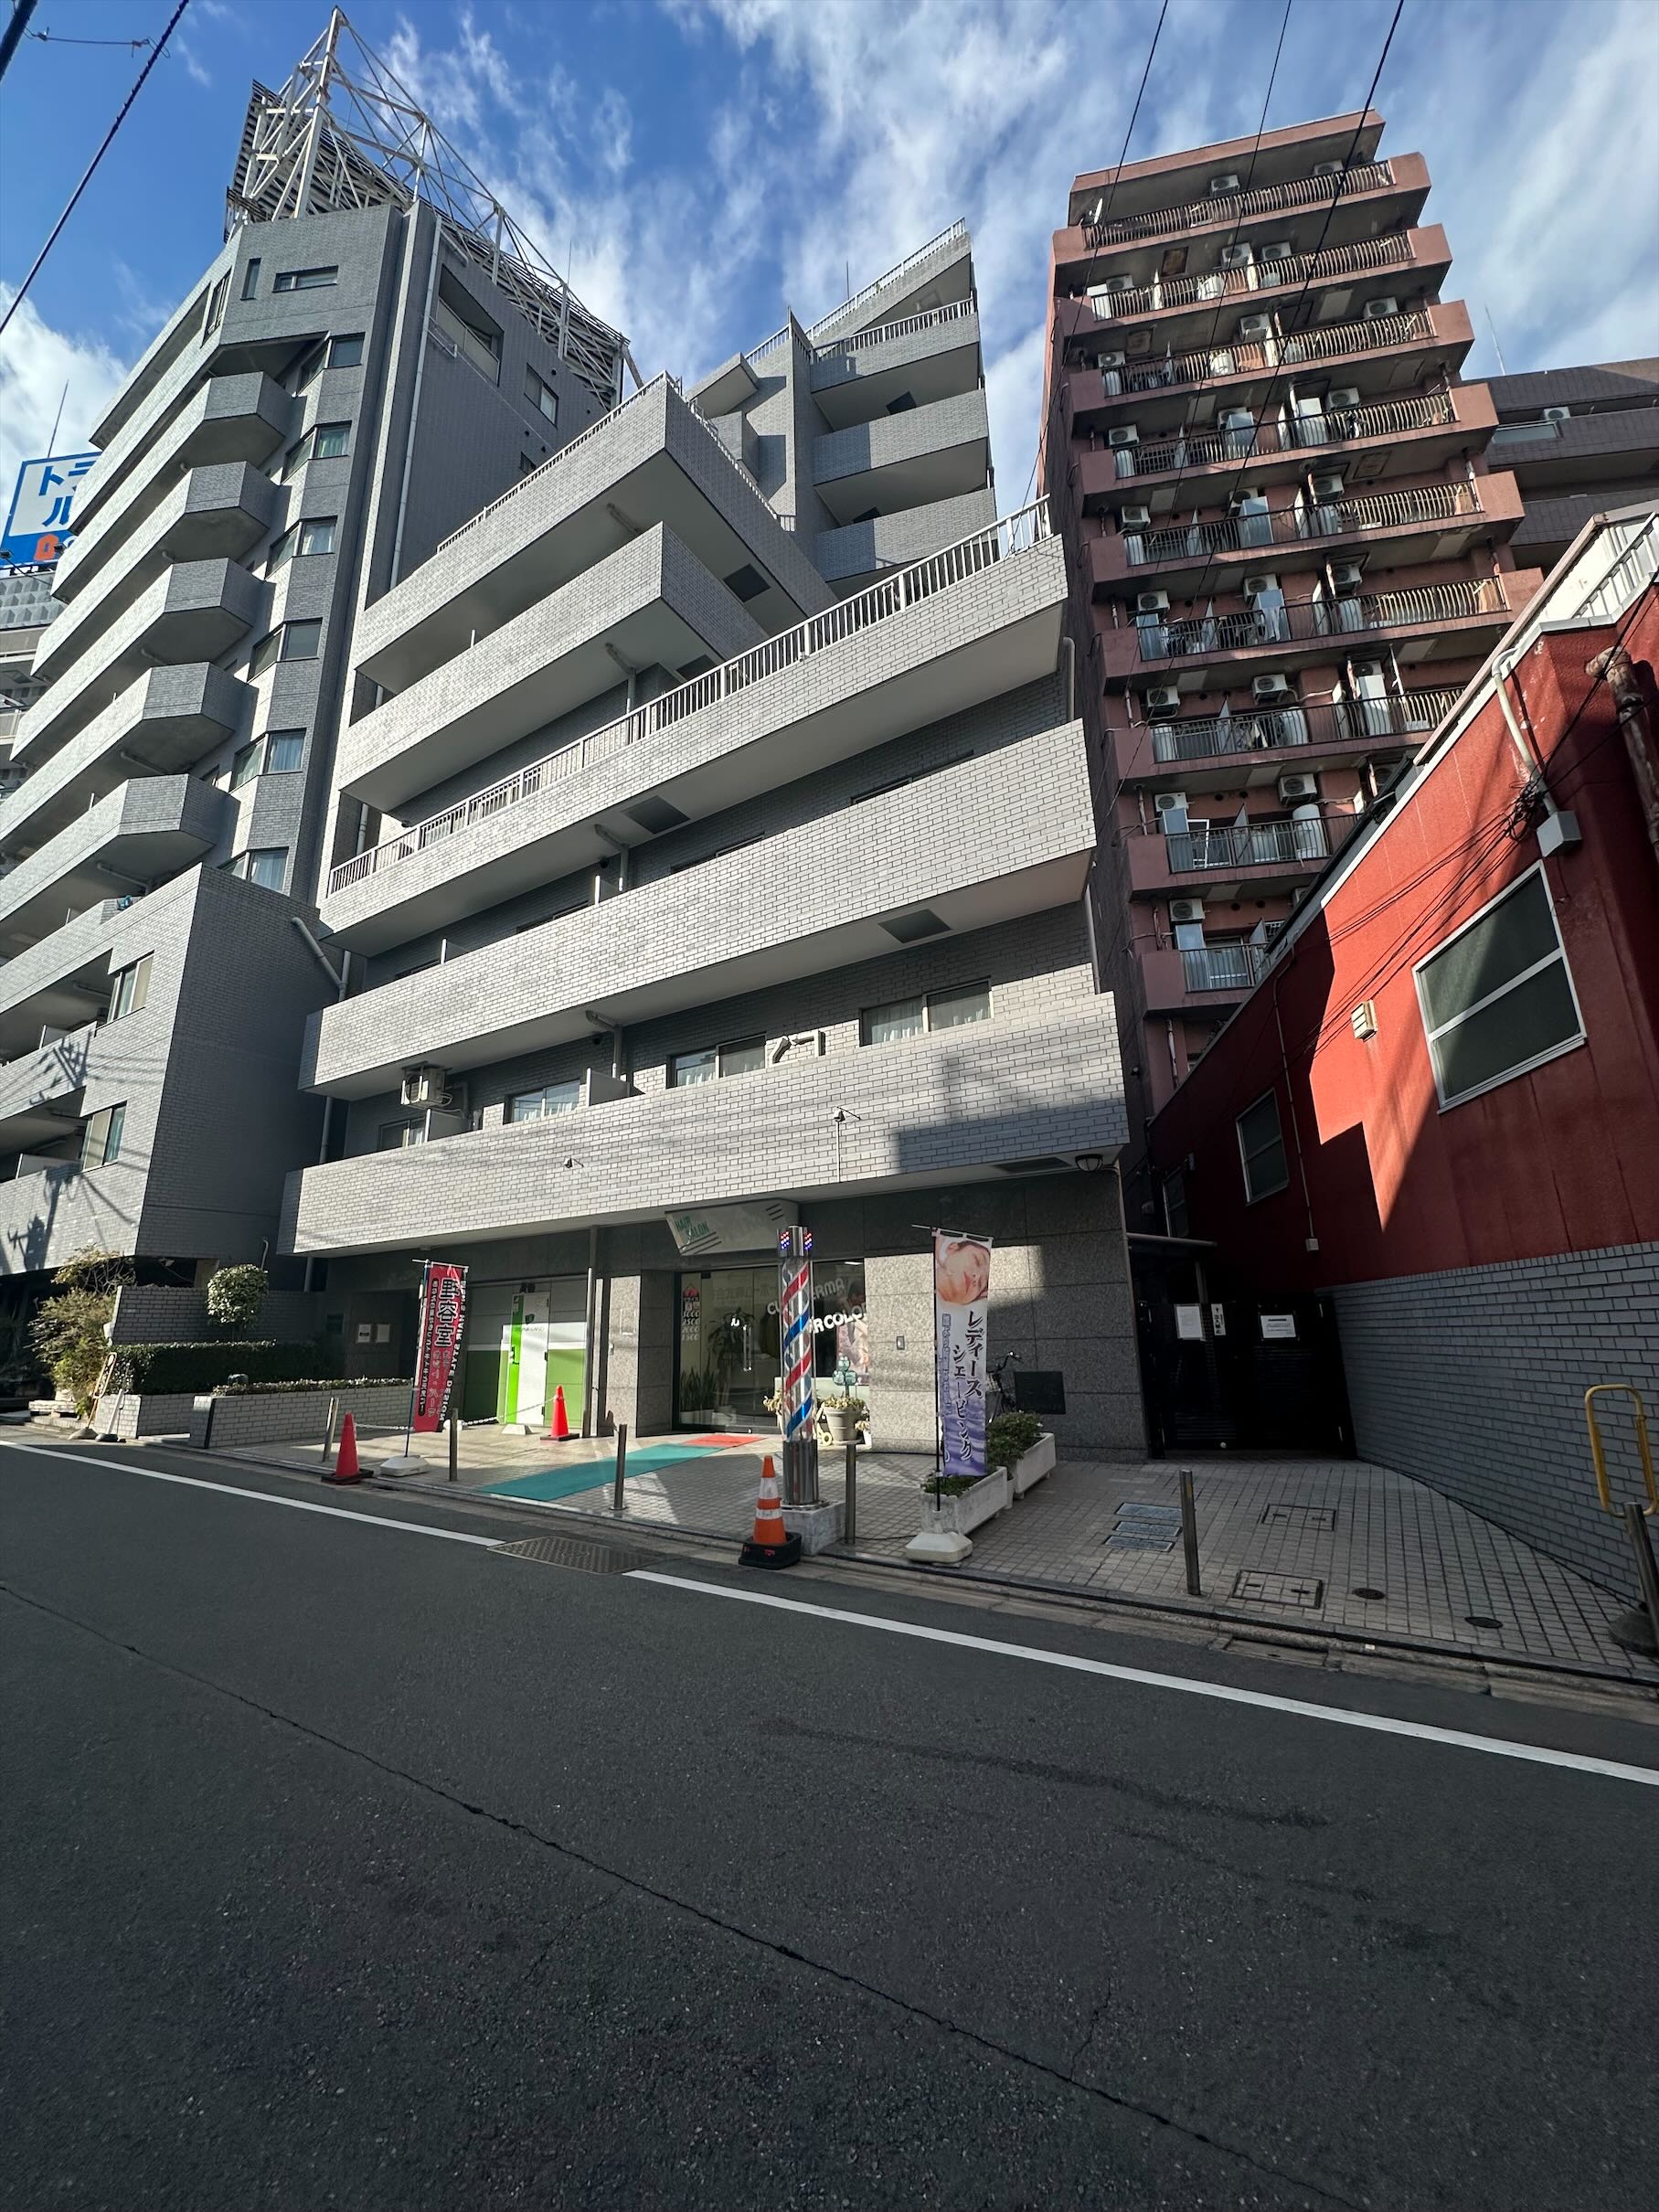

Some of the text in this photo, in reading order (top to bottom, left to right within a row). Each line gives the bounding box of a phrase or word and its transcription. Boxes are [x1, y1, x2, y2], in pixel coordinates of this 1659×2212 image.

[675, 1214, 693, 1232] HAIR
[686, 1220, 710, 1240] SALON
[963, 1310, 984, 1399] レディース
